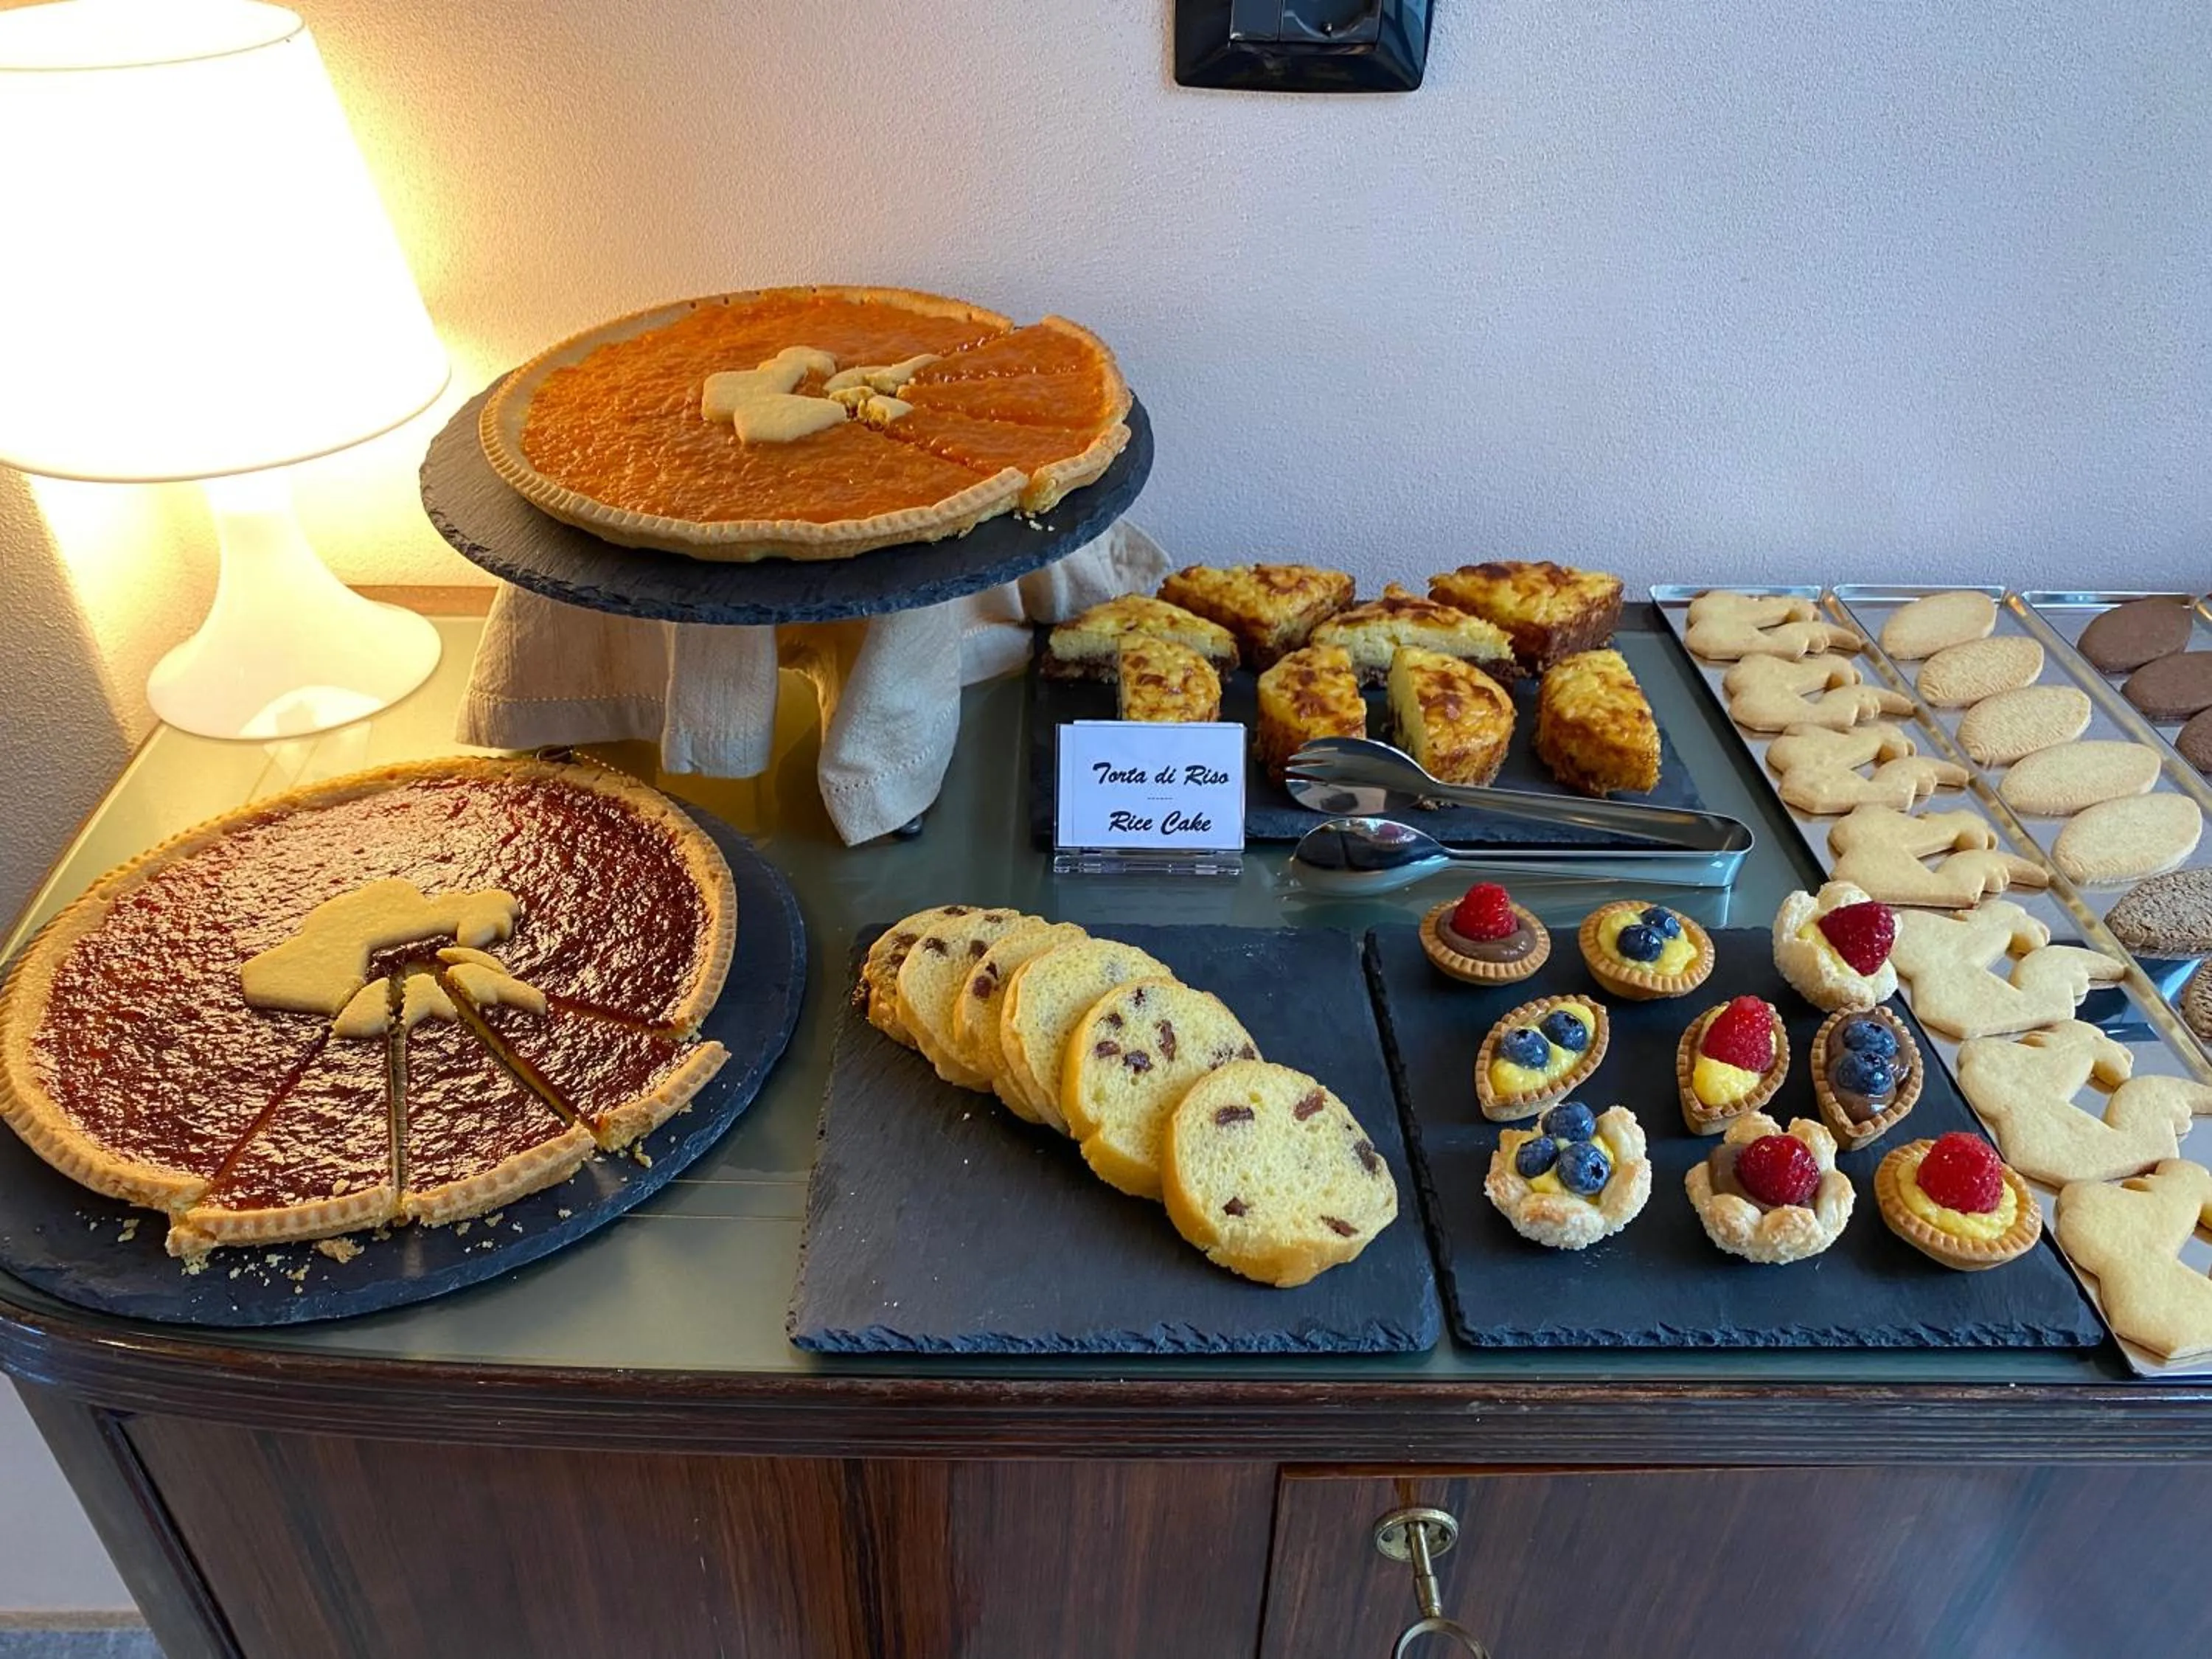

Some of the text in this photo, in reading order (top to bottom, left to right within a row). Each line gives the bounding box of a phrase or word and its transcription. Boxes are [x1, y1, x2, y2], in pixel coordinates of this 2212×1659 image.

[1093, 762, 1230, 786] Torta di Riso
[1108, 810, 1212, 835] Rice Cake
